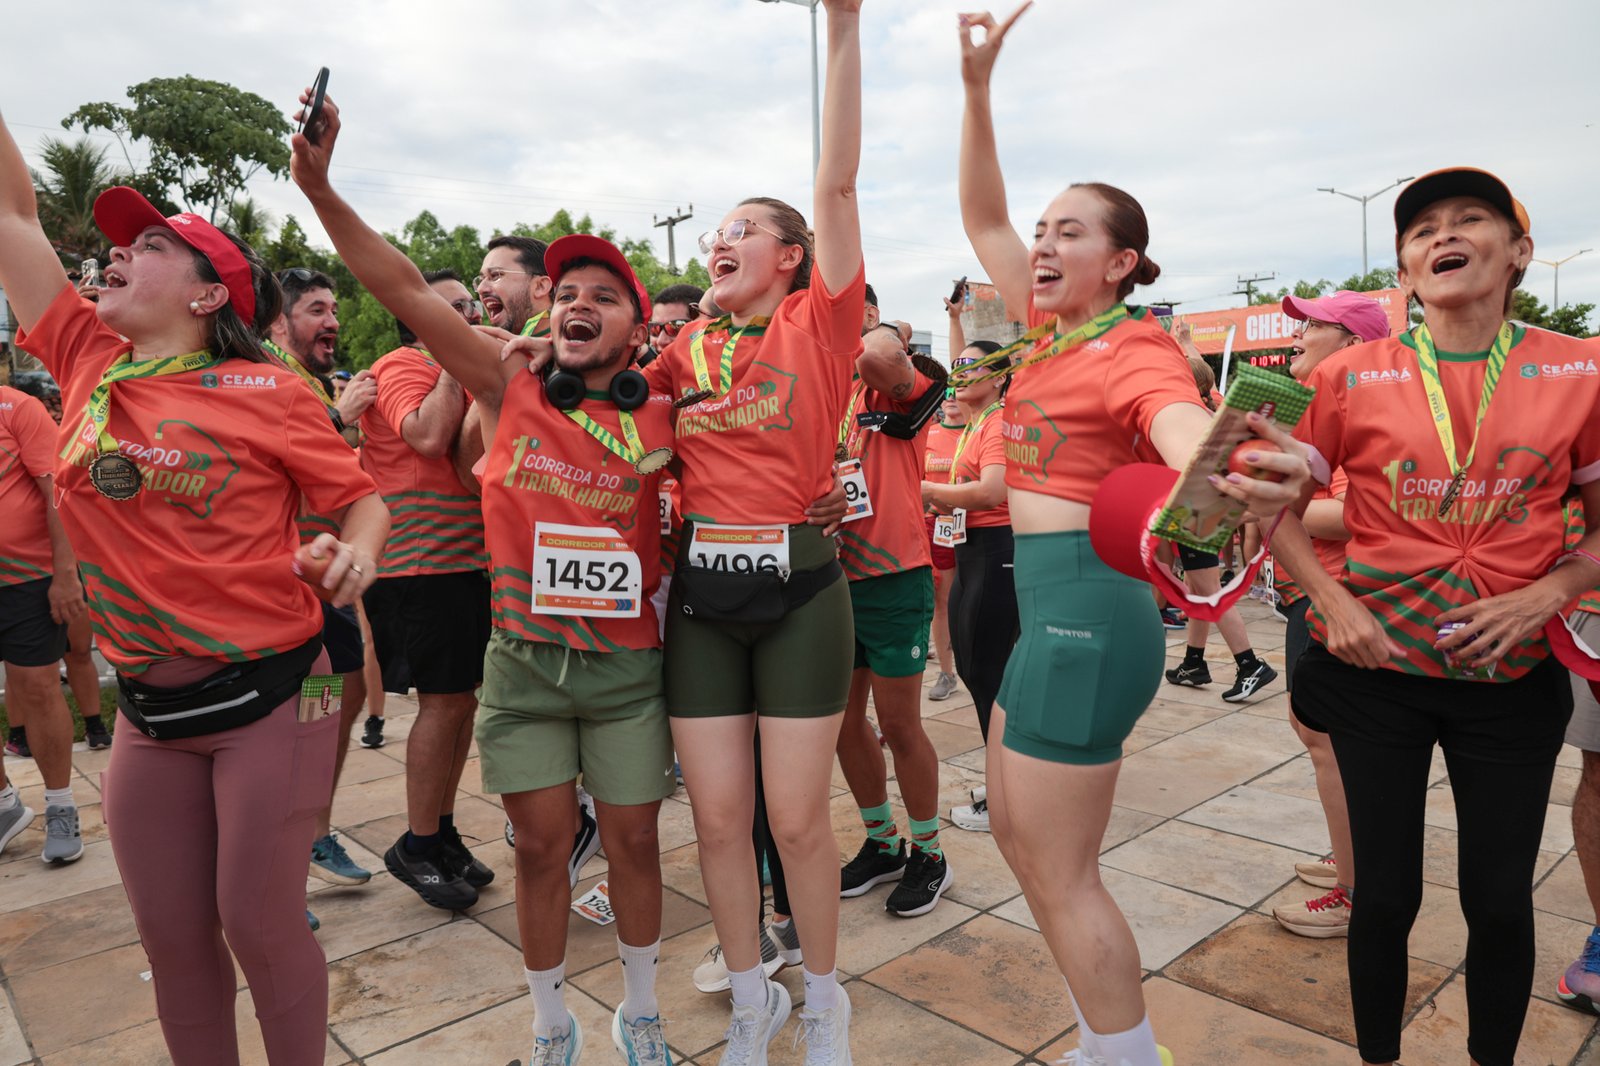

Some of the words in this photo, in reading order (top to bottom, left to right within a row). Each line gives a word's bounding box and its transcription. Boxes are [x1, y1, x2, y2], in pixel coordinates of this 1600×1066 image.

[1360, 366, 1412, 380] CEARÁ
[1542, 359, 1598, 374] CEARÁ
[222, 374, 277, 389] CEARÁ
[737, 385, 756, 404] DO
[681, 396, 780, 438] TRABALHADOR
[153, 447, 182, 467] DO
[524, 454, 592, 485] CORRIDA
[596, 473, 620, 489] DO
[519, 470, 635, 514] TRABALHADOR
[843, 481, 860, 501] 9
[1493, 478, 1522, 496] DO
[660, 499, 668, 518] 8
[700, 533, 753, 541] CORREDOR
[939, 525, 952, 537] 16
[546, 538, 606, 549] CORREDOR
[546, 557, 629, 592] 1452
[1266, 567, 1273, 589] 2
